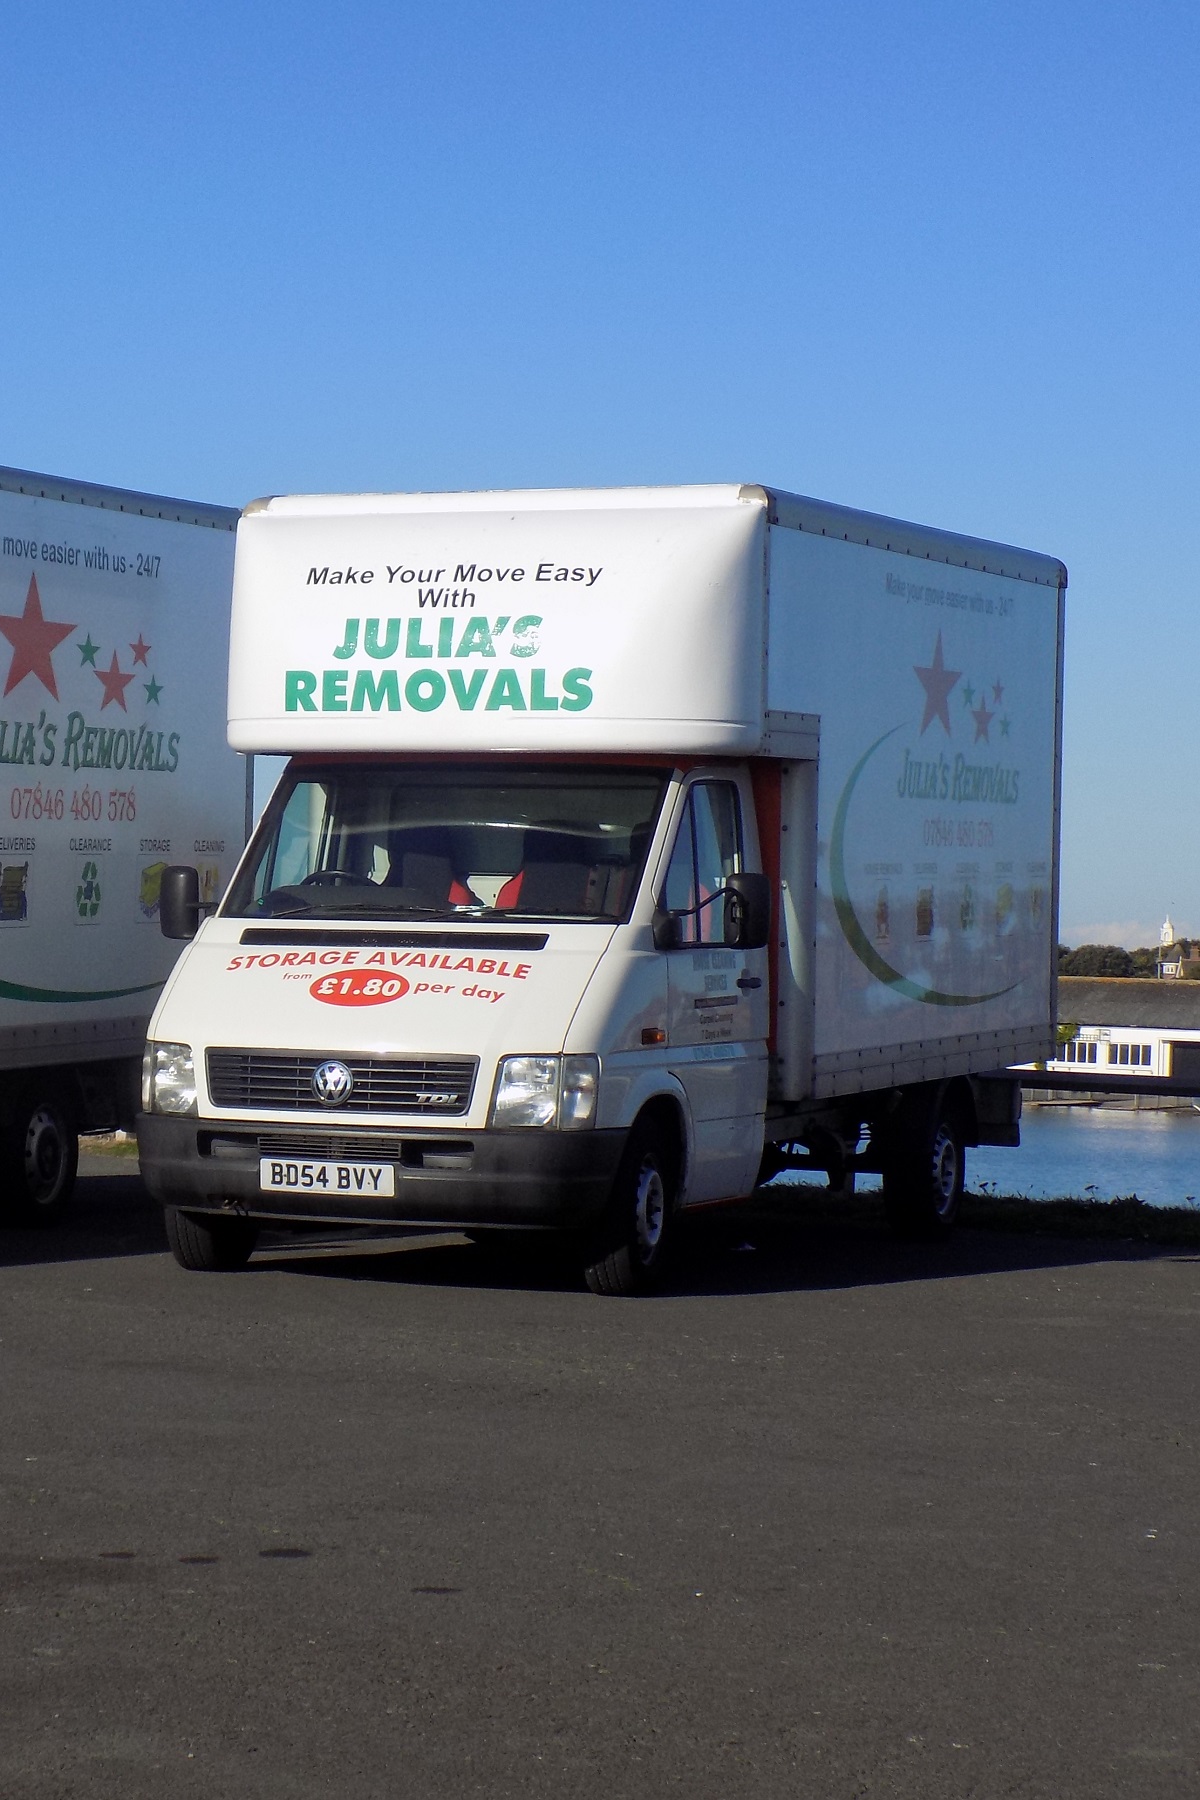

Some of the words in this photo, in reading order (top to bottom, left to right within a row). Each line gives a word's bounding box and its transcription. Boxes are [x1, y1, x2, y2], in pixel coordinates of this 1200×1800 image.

[3, 536, 37, 559] move
[41, 541, 81, 566] easier
[84, 545, 109, 571] with
[112, 556, 126, 573] us
[136, 552, 161, 578] 24/7
[306, 566, 375, 585] Make
[385, 565, 446, 584] Your
[453, 564, 526, 583] Move
[534, 563, 604, 587] Easy
[417, 588, 476, 608] With
[332, 615, 544, 660] JULIA'S
[285, 667, 593, 712] REMOVALS
[10, 781, 65, 820] 07846
[70, 783, 102, 821] 480
[107, 785, 137, 821] 578
[69, 838, 112, 852] CLEARANCE
[139, 839, 171, 852] STORAGE
[193, 840, 225, 852] CLEANING
[226, 950, 360, 971] STORAGE
[364, 951, 532, 980] AVAILABLE
[282, 972, 313, 981] from
[317, 977, 402, 997] £1.80
[413, 981, 456, 995] per
[462, 983, 506, 1004] day
[416, 1093, 458, 1103] TDI
[271, 1162, 329, 1188] BD54
[337, 1166, 382, 1190] BVY
